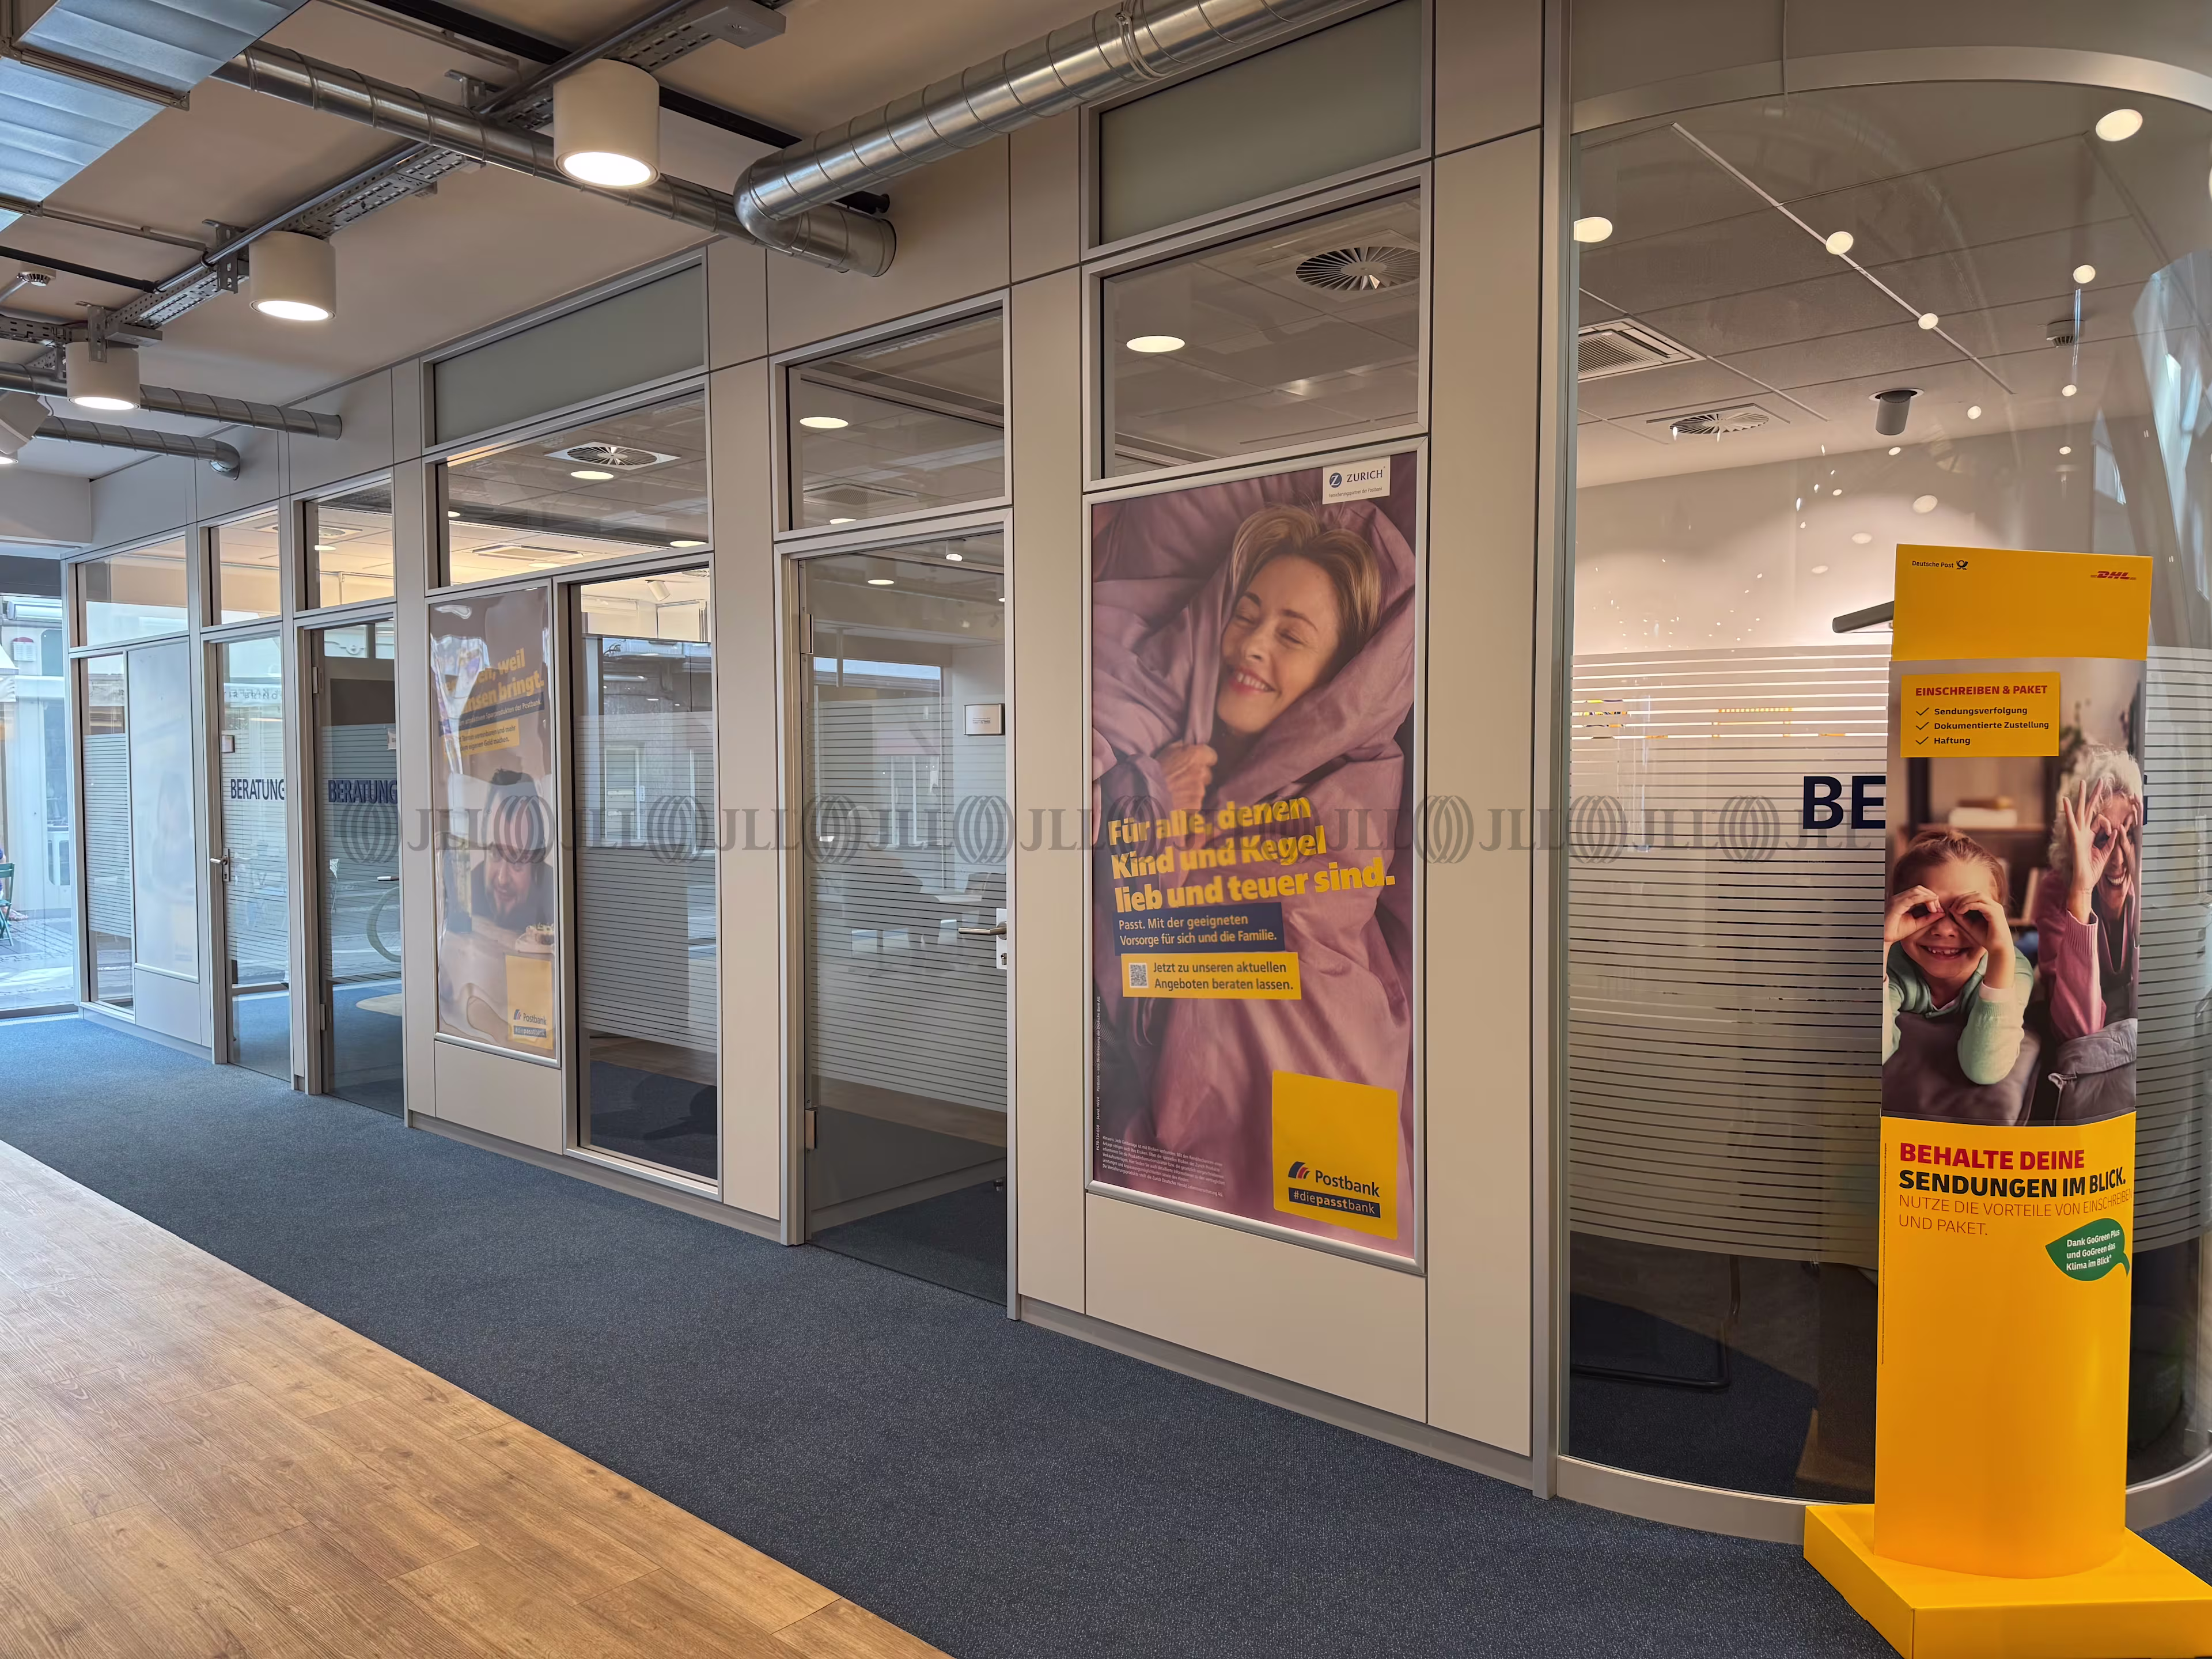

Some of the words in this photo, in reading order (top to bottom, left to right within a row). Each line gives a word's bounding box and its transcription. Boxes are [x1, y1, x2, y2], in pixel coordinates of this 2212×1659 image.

[1346, 469, 1383, 483] ZURICH
[1912, 560, 1940, 568] Deutsche
[2096, 570, 2131, 579] DHL
[498, 670, 544, 701] bringt.
[1915, 686, 1999, 696] EINSCHREIBEN
[2002, 686, 2010, 694] &
[2013, 685, 2048, 694] PAKET
[1934, 706, 2028, 715] Sendungsverfolgung
[1934, 721, 2002, 729] Dokumentierte
[2004, 720, 2049, 730] Zustellung
[1934, 736, 1971, 745] Haftung
[230, 779, 285, 801] BERATUNG
[328, 780, 397, 804] BERATUNG
[1108, 819, 1150, 846] Für
[1156, 805, 1213, 840] alle,
[1217, 797, 1312, 830] denen
[1111, 846, 1174, 880] Kind
[1179, 838, 1236, 870] und
[1240, 825, 1327, 865] Kegel
[1115, 883, 1162, 913] lieb
[1167, 875, 1224, 907] und
[1228, 872, 1309, 901] teuer
[1315, 857, 1396, 892] sind.
[1119, 918, 1145, 930] Passt.
[1147, 917, 1165, 929] Mit
[1168, 916, 1184, 929] der
[1187, 914, 1248, 930] geeigneten
[1120, 934, 1159, 947] Vorsorge
[1161, 933, 1175, 945] für
[1177, 932, 1195, 944] sich
[1198, 931, 1217, 943] und
[1221, 931, 1235, 942] die
[1238, 929, 1277, 942] Familie.
[1153, 962, 1176, 973] Jetzt
[1177, 964, 1190, 972] zu
[1192, 964, 1234, 972] unseren
[1237, 961, 1286, 972] aktuellen
[1154, 978, 1209, 991] Angeboten
[1213, 979, 1253, 990] beraten
[1256, 978, 1293, 990] lassen.
[524, 1013, 546, 1025] Postbank
[1900, 1142, 2013, 1170] BEHALTE
[2020, 1149, 2085, 1171] DEINE
[1315, 1169, 1380, 1198] Postbank
[1899, 1170, 2057, 1198] SENDUNGEN
[2063, 1178, 2086, 1195] IM
[2089, 1166, 2126, 1194] BLICK.
[1293, 1190, 1376, 1214] #diepasstbank
[1899, 1194, 1949, 1213] NUTZE
[1955, 1200, 1979, 1214] DIE
[1983, 1202, 2051, 1217] VORTEILE
[2055, 1199, 2081, 1215] VON
[1899, 1214, 1932, 1230] UND
[1937, 1219, 1987, 1236] PAKET.
[2067, 1238, 2085, 1247] Dank
[2086, 1233, 2110, 1245] GoGreen
[2111, 1229, 2120, 1238] Plus
[2067, 1250, 2081, 1259] und
[2082, 1246, 2107, 1257] GoGreen
[2107, 1243, 2116, 1251] das
[2066, 1262, 2087, 1271] Klima
